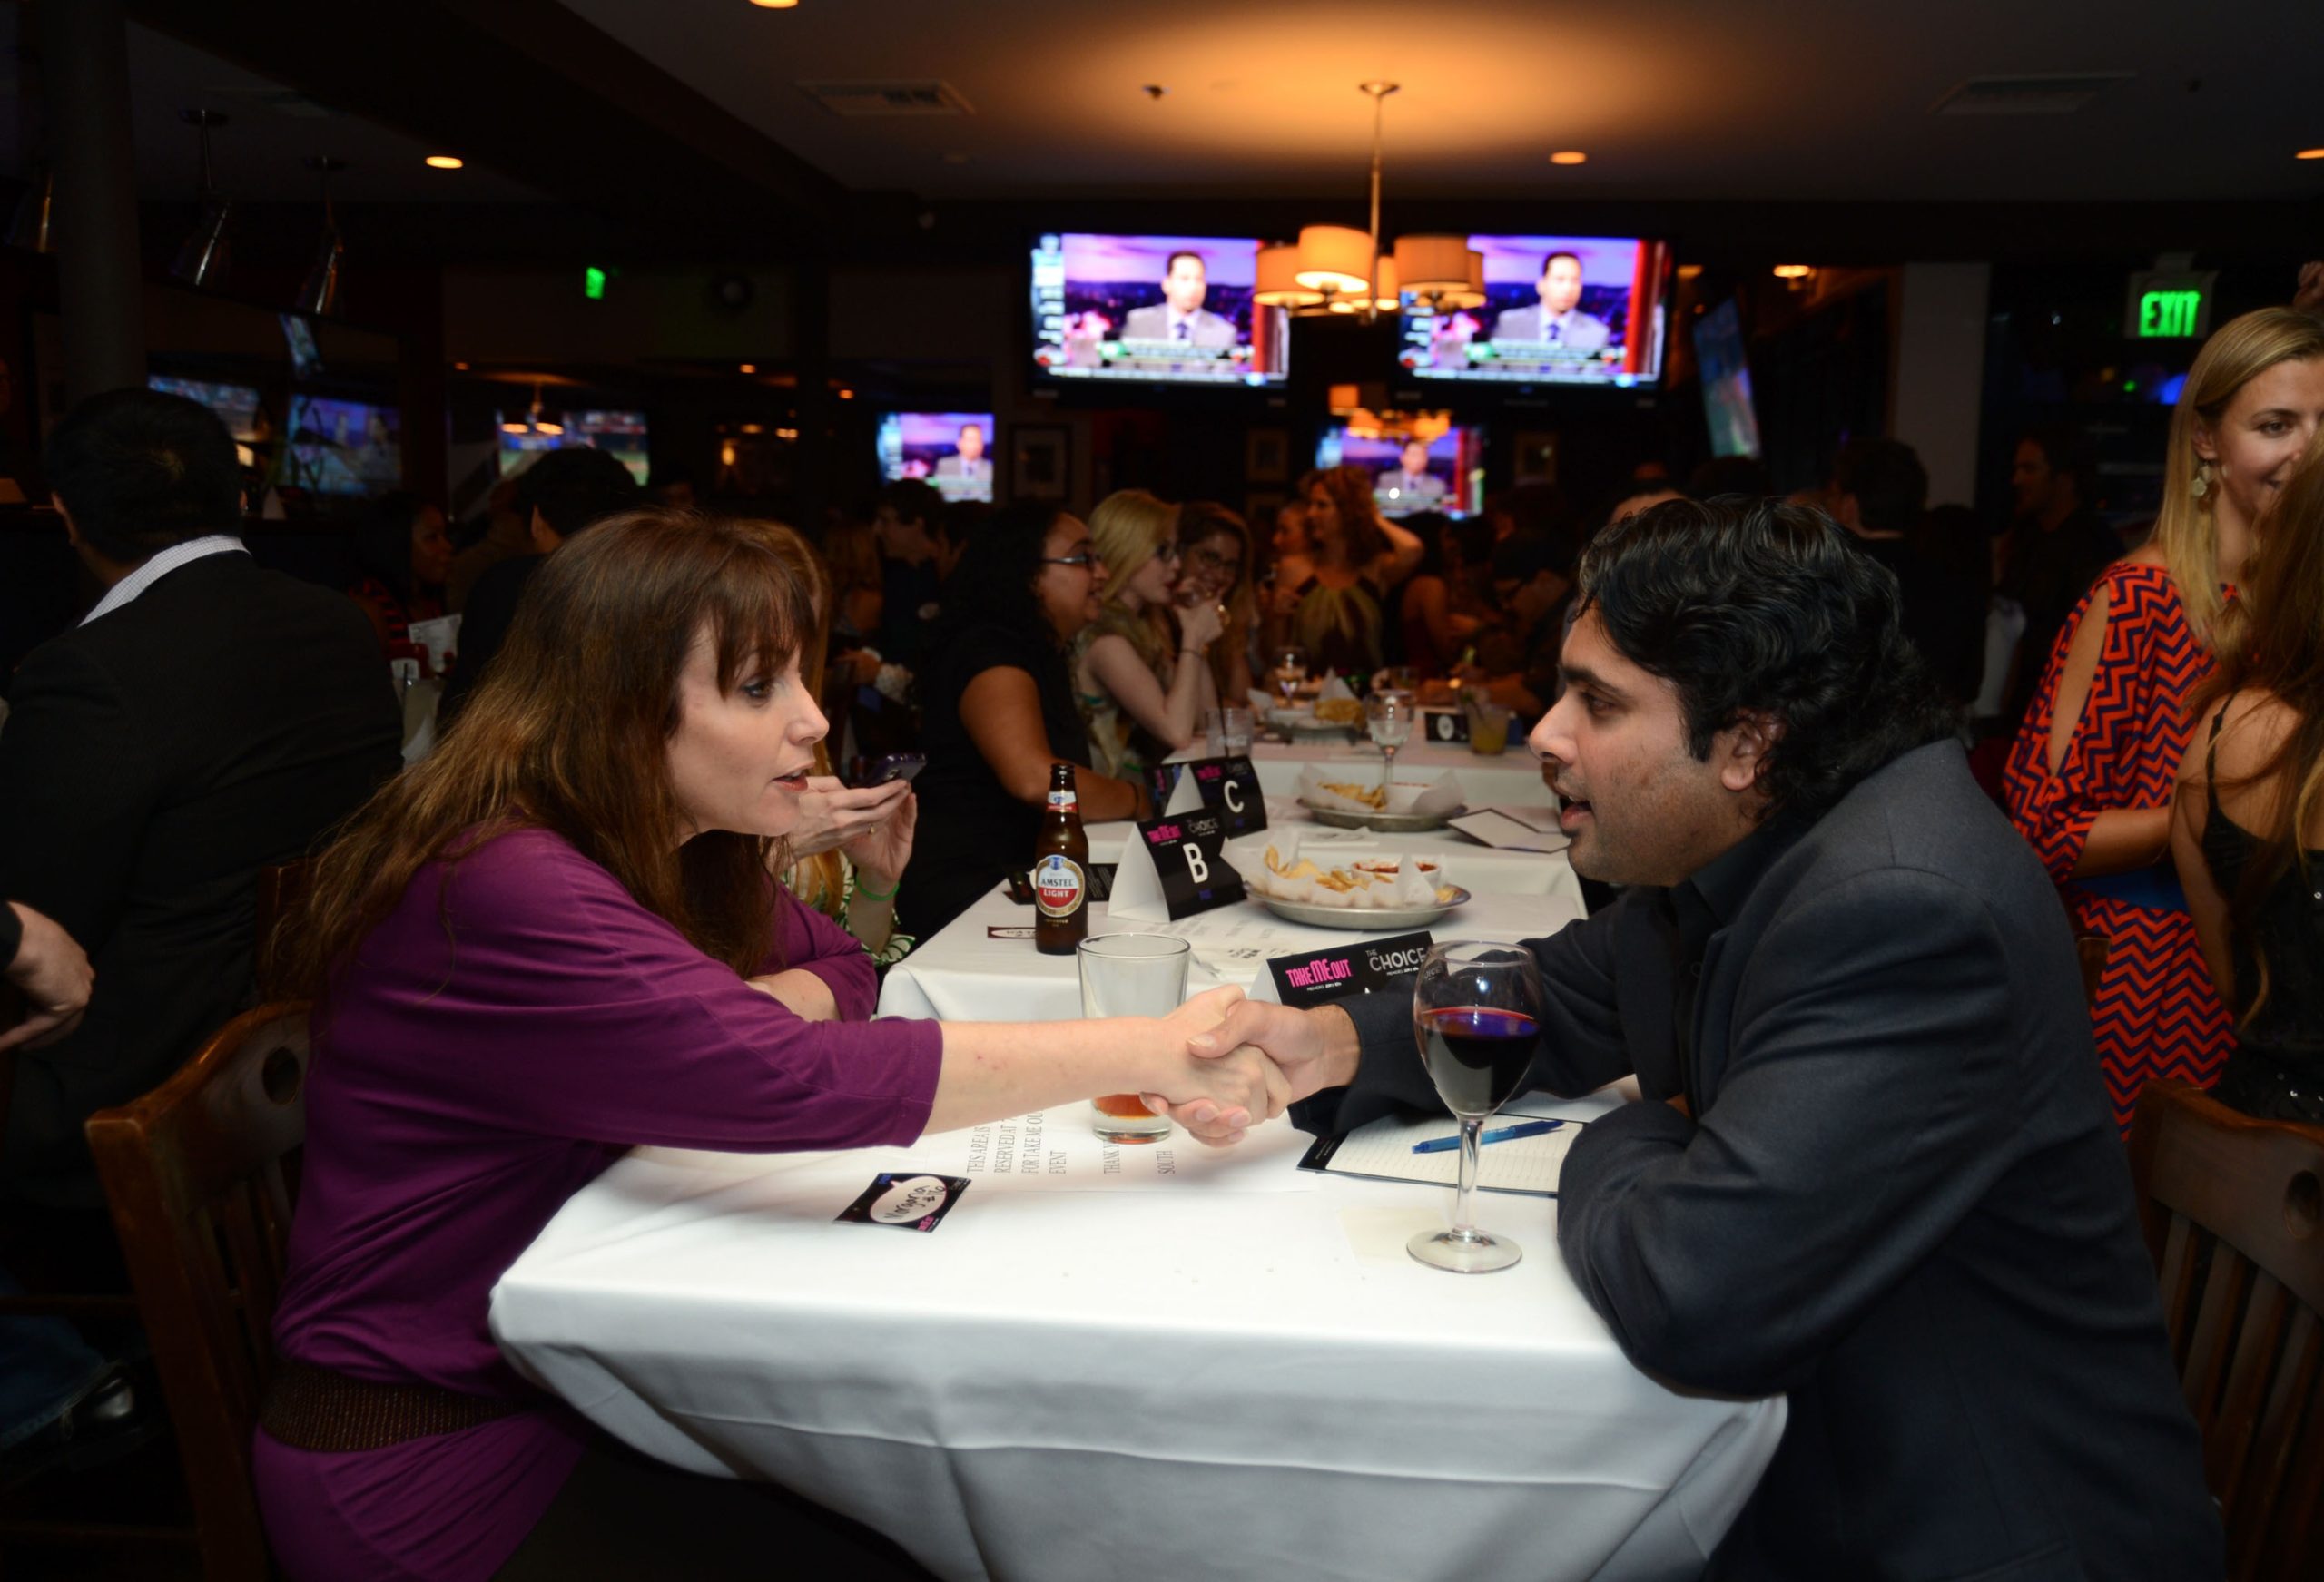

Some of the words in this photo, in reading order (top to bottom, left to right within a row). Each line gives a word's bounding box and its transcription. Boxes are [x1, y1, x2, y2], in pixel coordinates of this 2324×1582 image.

[2139, 290, 2201, 338] EXIT
[1224, 780, 1245, 813] C
[1182, 842, 1208, 884] B
[1040, 878, 1074, 888] AMSTEL
[1043, 889, 1070, 898] LIGHT
[1364, 948, 1378, 958] THE
[1369, 947, 1426, 972] CHOICE
[1285, 968, 1313, 988] TAKE
[1309, 958, 1334, 984] ME
[1332, 958, 1353, 979] OUT
[1025, 1125, 1042, 1136] ME
[970, 1133, 990, 1155] AREA
[994, 1134, 1016, 1174] RESERVED
[1022, 1137, 1041, 1158] TAKE
[967, 1155, 986, 1174] THIS
[1021, 1159, 1039, 1174] FOR
[1049, 1149, 1067, 1174] EVENT
[1103, 1150, 1121, 1174] THANK
[1156, 1150, 1176, 1174] SOUTH
